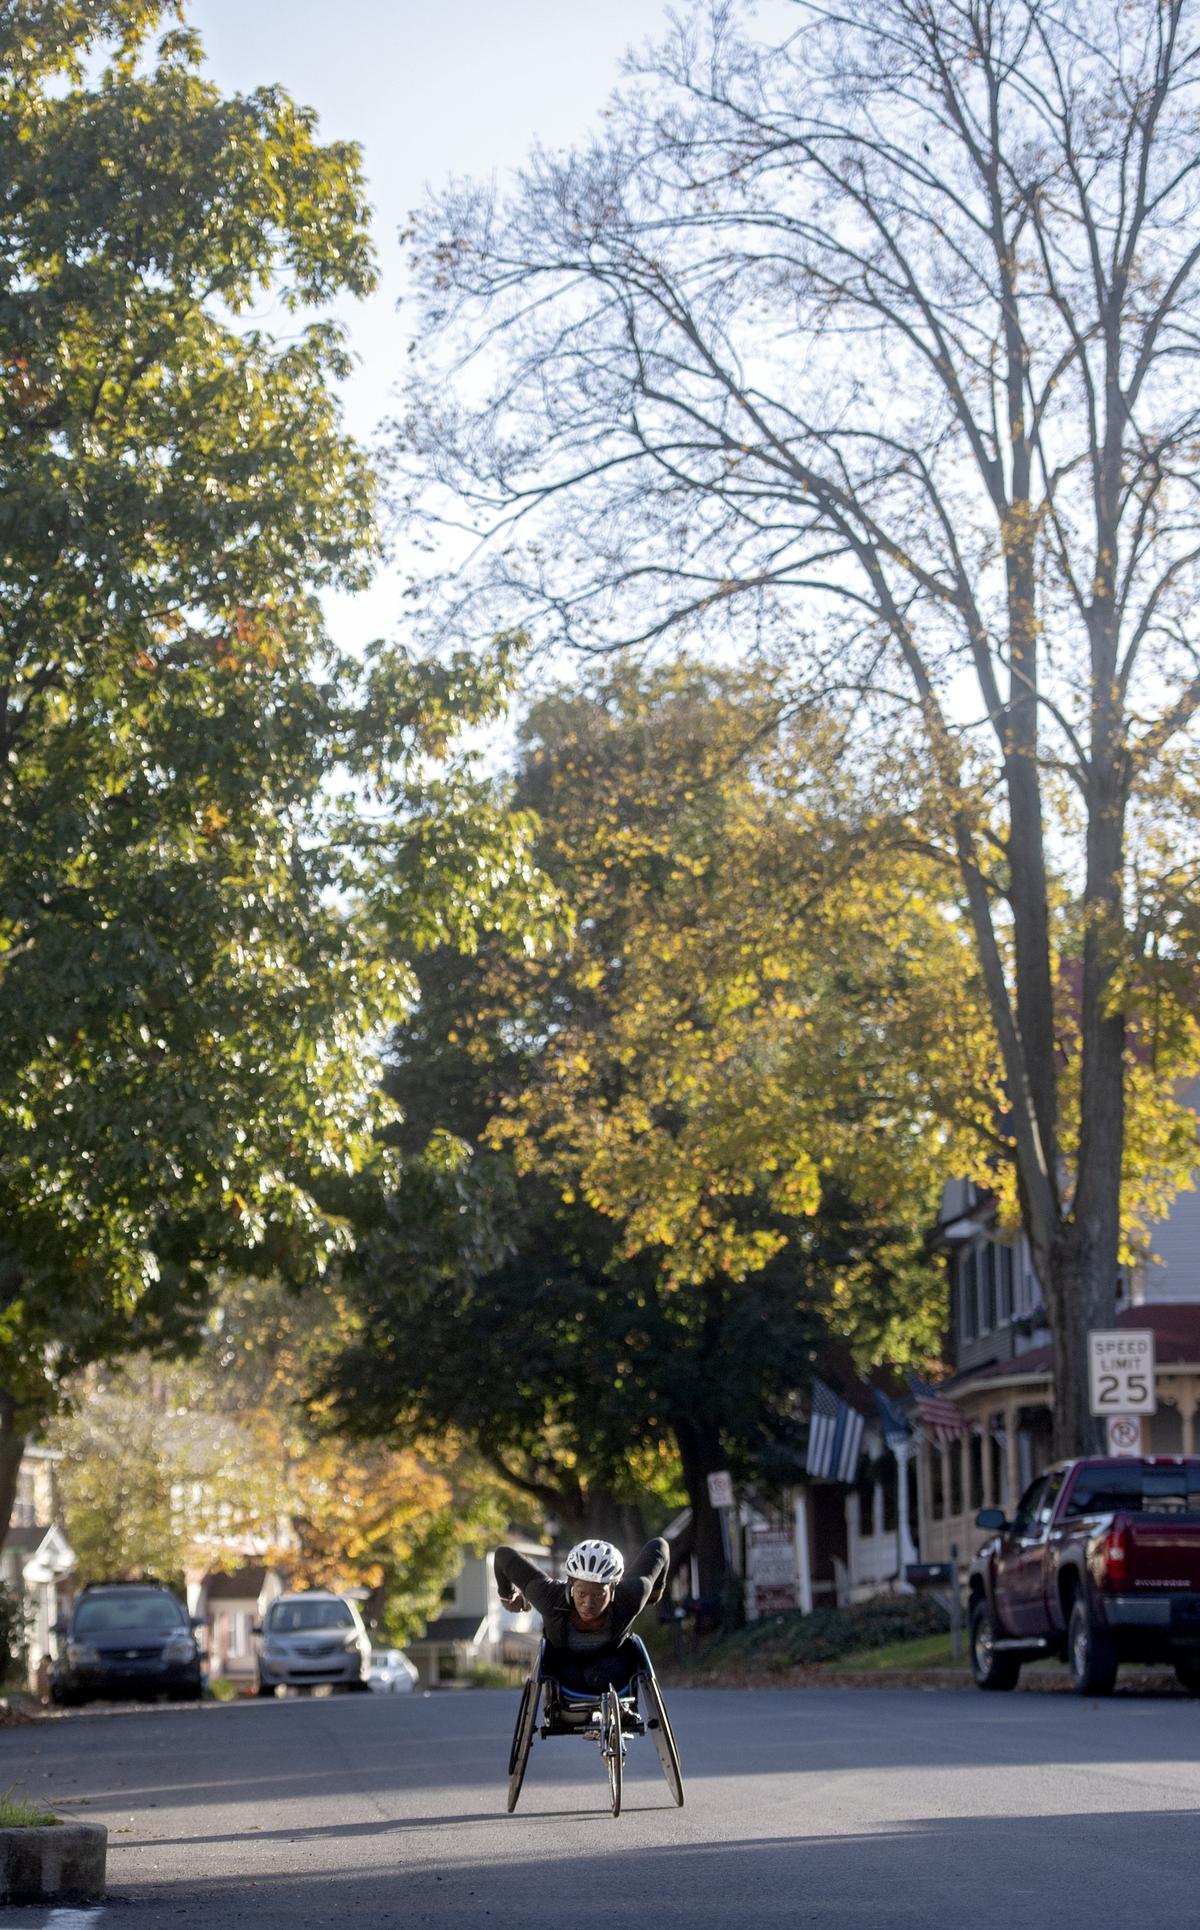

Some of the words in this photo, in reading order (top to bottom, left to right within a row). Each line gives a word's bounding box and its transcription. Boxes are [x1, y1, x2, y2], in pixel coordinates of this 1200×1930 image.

[1096, 1341, 1147, 1355] SPEED
[1101, 1358, 1142, 1372] LIMIT
[1099, 1375, 1148, 1403] 25
